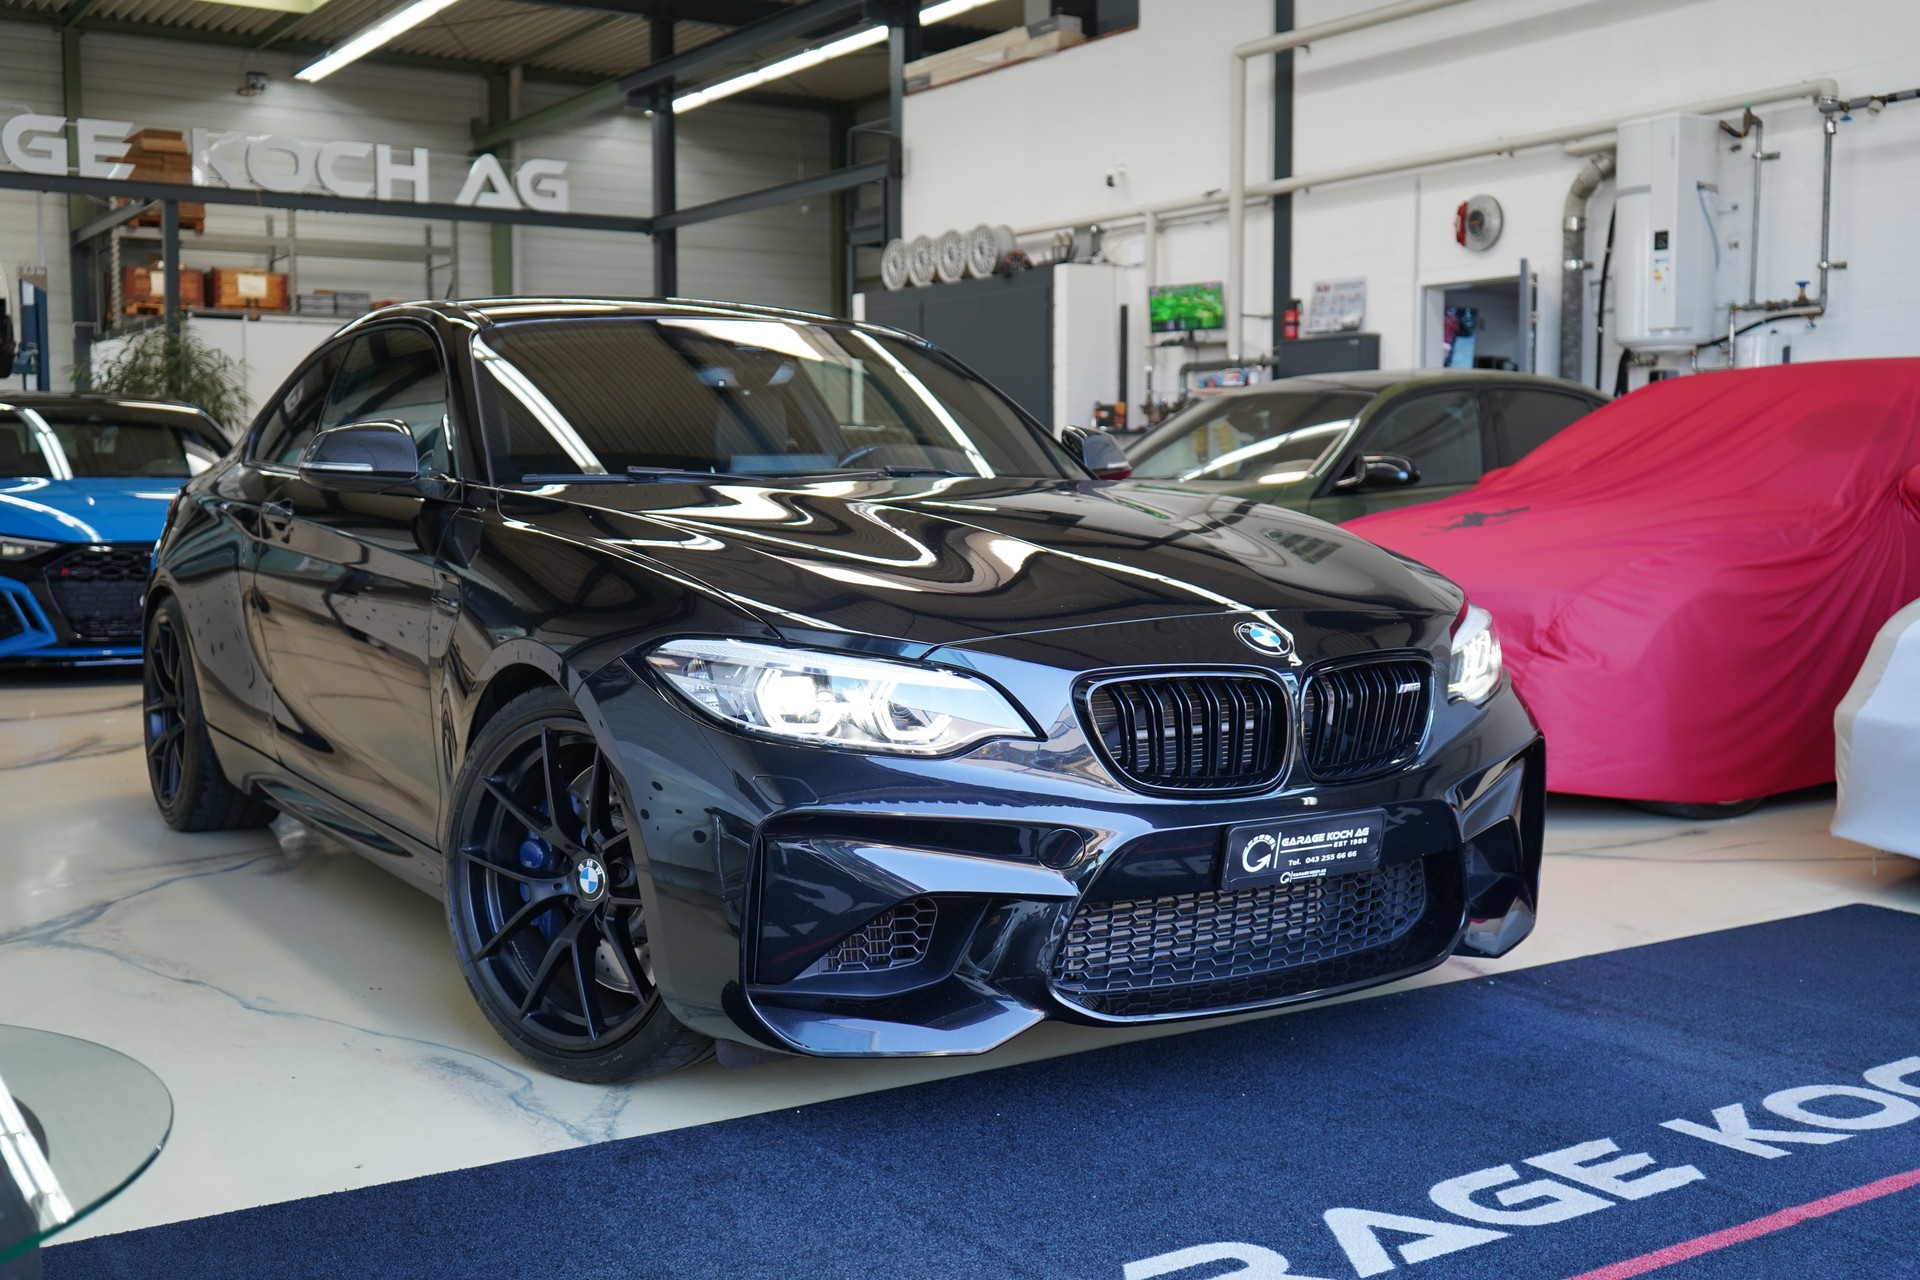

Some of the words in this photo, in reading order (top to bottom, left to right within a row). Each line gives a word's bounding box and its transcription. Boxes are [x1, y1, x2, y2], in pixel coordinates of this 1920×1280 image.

[2, 113, 136, 180] GE
[192, 128, 429, 203] KOCH
[455, 152, 569, 213] AG
[1282, 833, 1325, 847] GARAGE
[1326, 829, 1354, 841] KOCH
[1354, 827, 1370, 838] AG
[1333, 840, 1348, 848] EST
[1305, 856, 1320, 864] 043
[1321, 853, 1336, 862] 255
[1336, 852, 1347, 860] 66
[1347, 850, 1358, 858] 66
[578, 859, 602, 875] BMW
